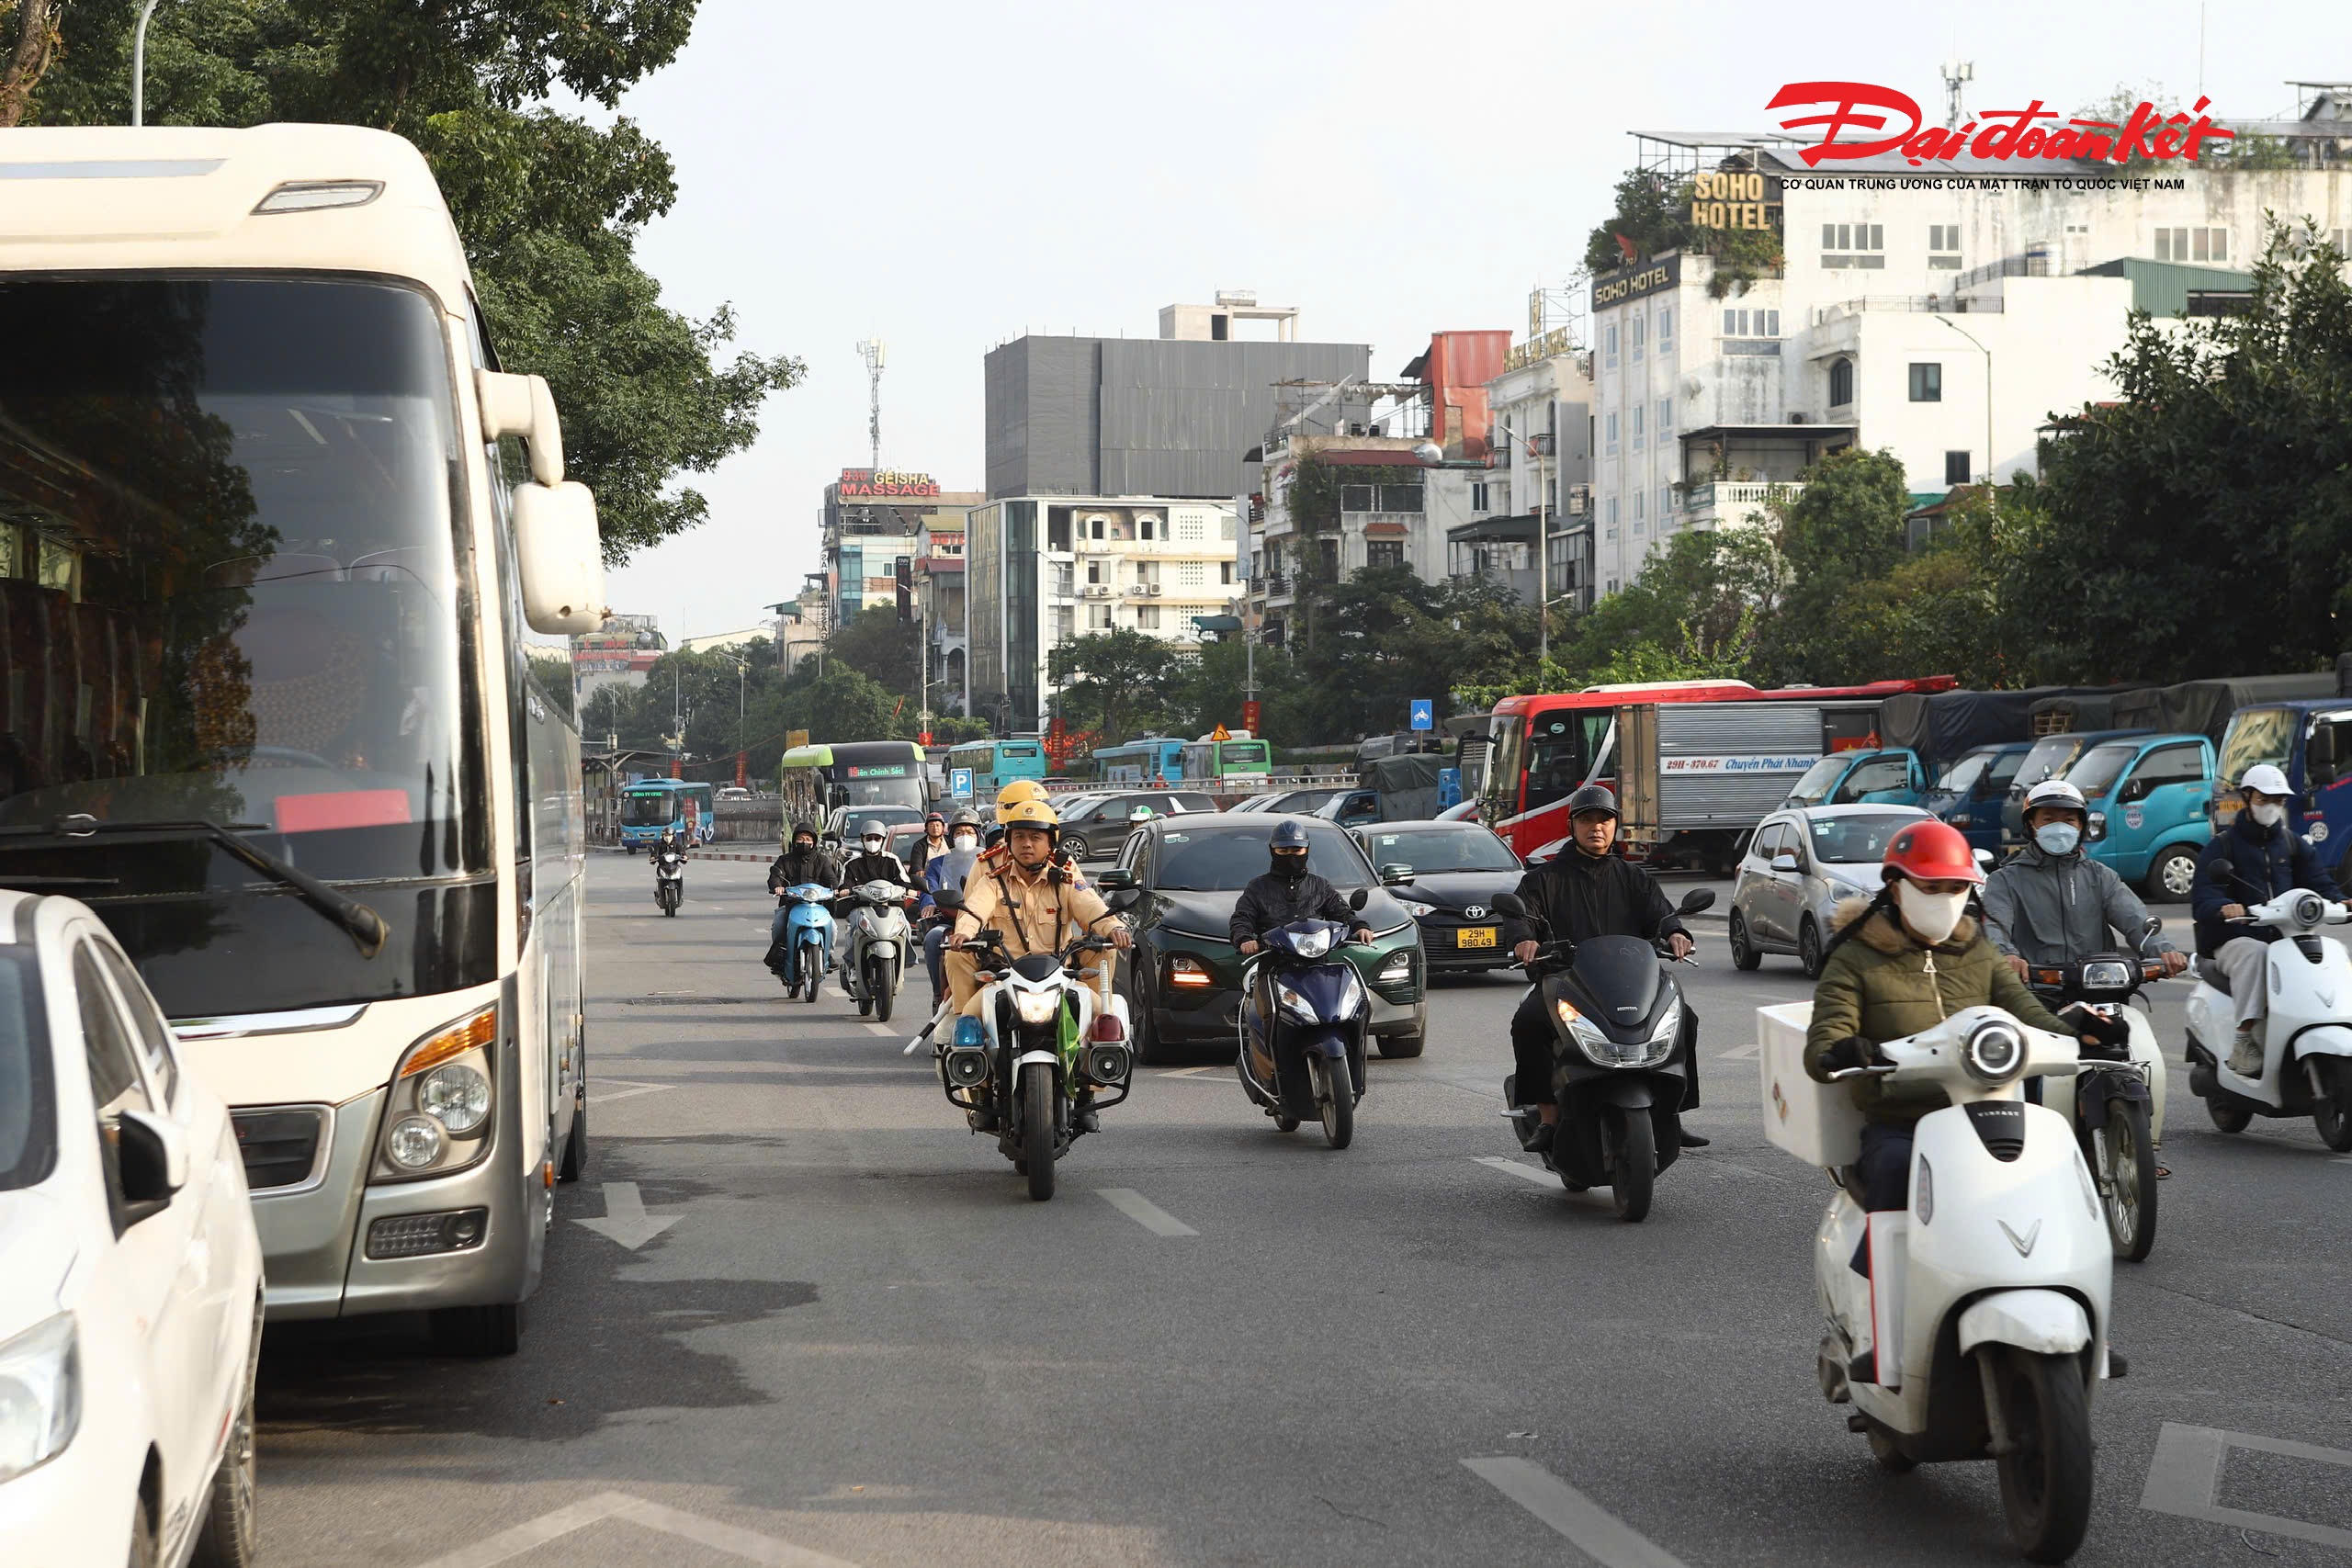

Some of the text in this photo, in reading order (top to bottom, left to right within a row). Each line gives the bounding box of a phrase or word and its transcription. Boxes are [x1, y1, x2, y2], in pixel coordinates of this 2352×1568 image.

[1695, 172, 1764, 201] SOHO
[1691, 201, 1770, 230] HOTEL
[1595, 265, 1669, 305] SOHO HOTEL
[874, 472, 929, 485] GEISHA
[841, 483, 941, 496] MASSAGE
[1666, 760, 1685, 770] 29H
[1761, 757, 1782, 770] Phát
[956, 774, 967, 789] P
[1468, 930, 1485, 939] 29H
[1461, 938, 1493, 947] 980.49
